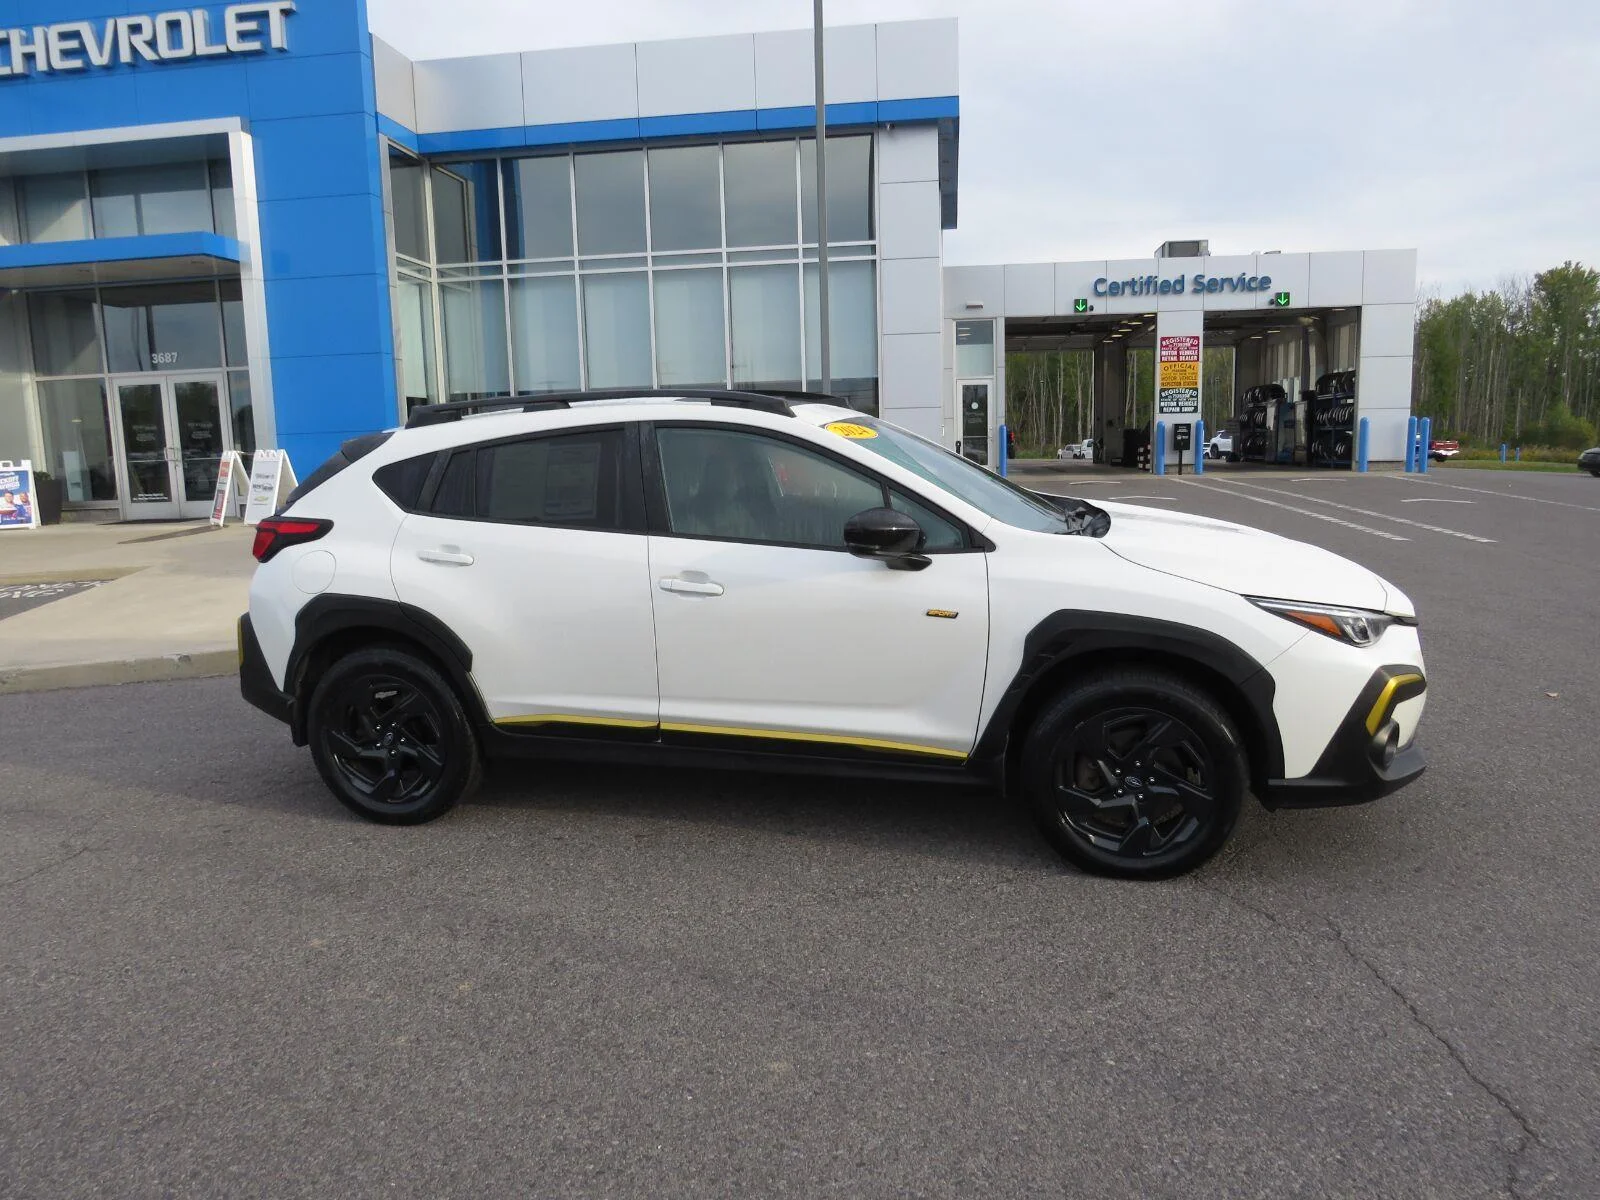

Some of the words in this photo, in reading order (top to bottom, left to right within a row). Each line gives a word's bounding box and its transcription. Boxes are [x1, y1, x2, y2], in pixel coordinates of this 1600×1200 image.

[1093, 275, 1185, 297] Certified
[1192, 272, 1272, 293] Service
[1162, 336, 1198, 346] REGISTERED
[152, 352, 178, 364] 3687
[1163, 363, 1196, 371] OFFICIAL
[1161, 388, 1197, 397] REGISTERED
[833, 425, 871, 437] 2024
